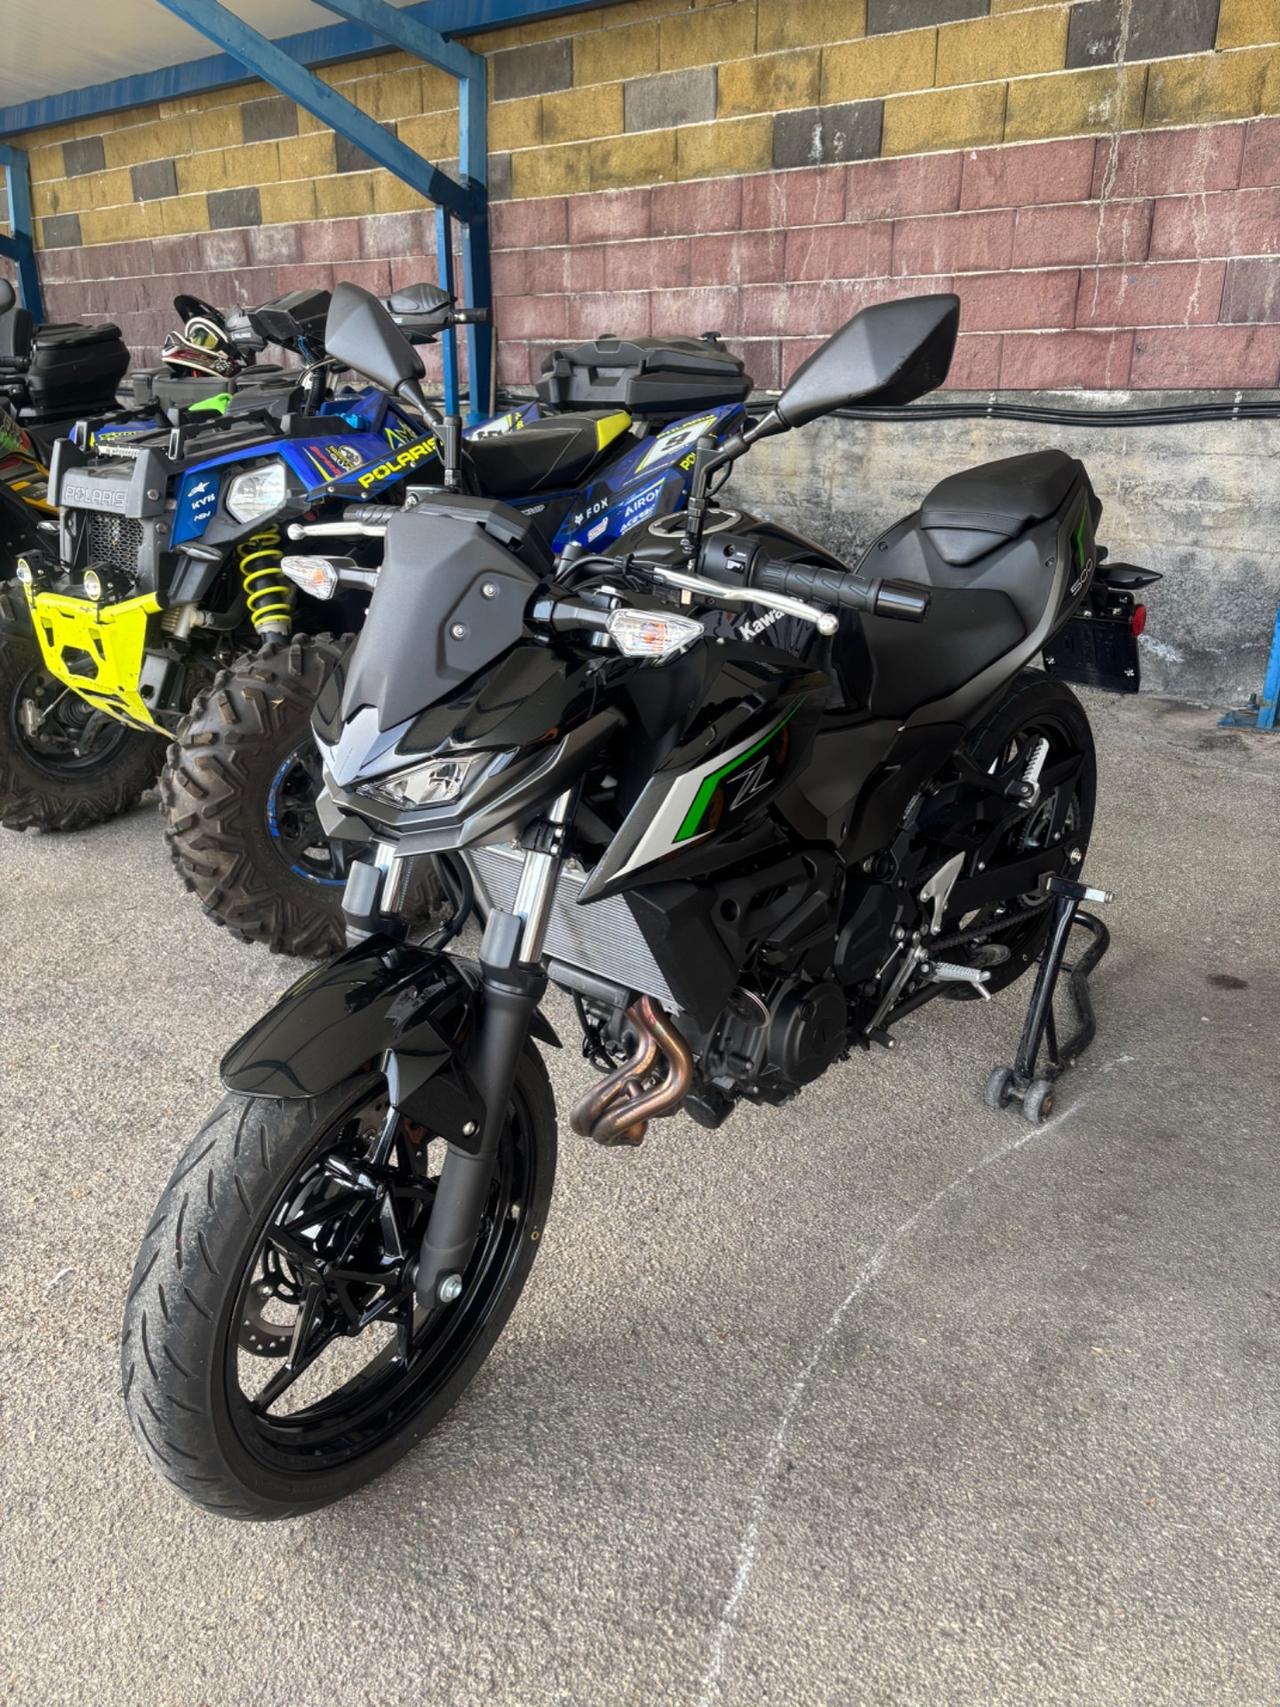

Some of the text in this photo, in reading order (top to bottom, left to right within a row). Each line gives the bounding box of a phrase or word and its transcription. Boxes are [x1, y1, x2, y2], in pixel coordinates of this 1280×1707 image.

[680, 452, 696, 471] PO
[65, 485, 127, 508] POLARIS
[586, 497, 608, 519] FOX
[1070, 557, 1094, 597] 500
[739, 608, 785, 641] Kawa
